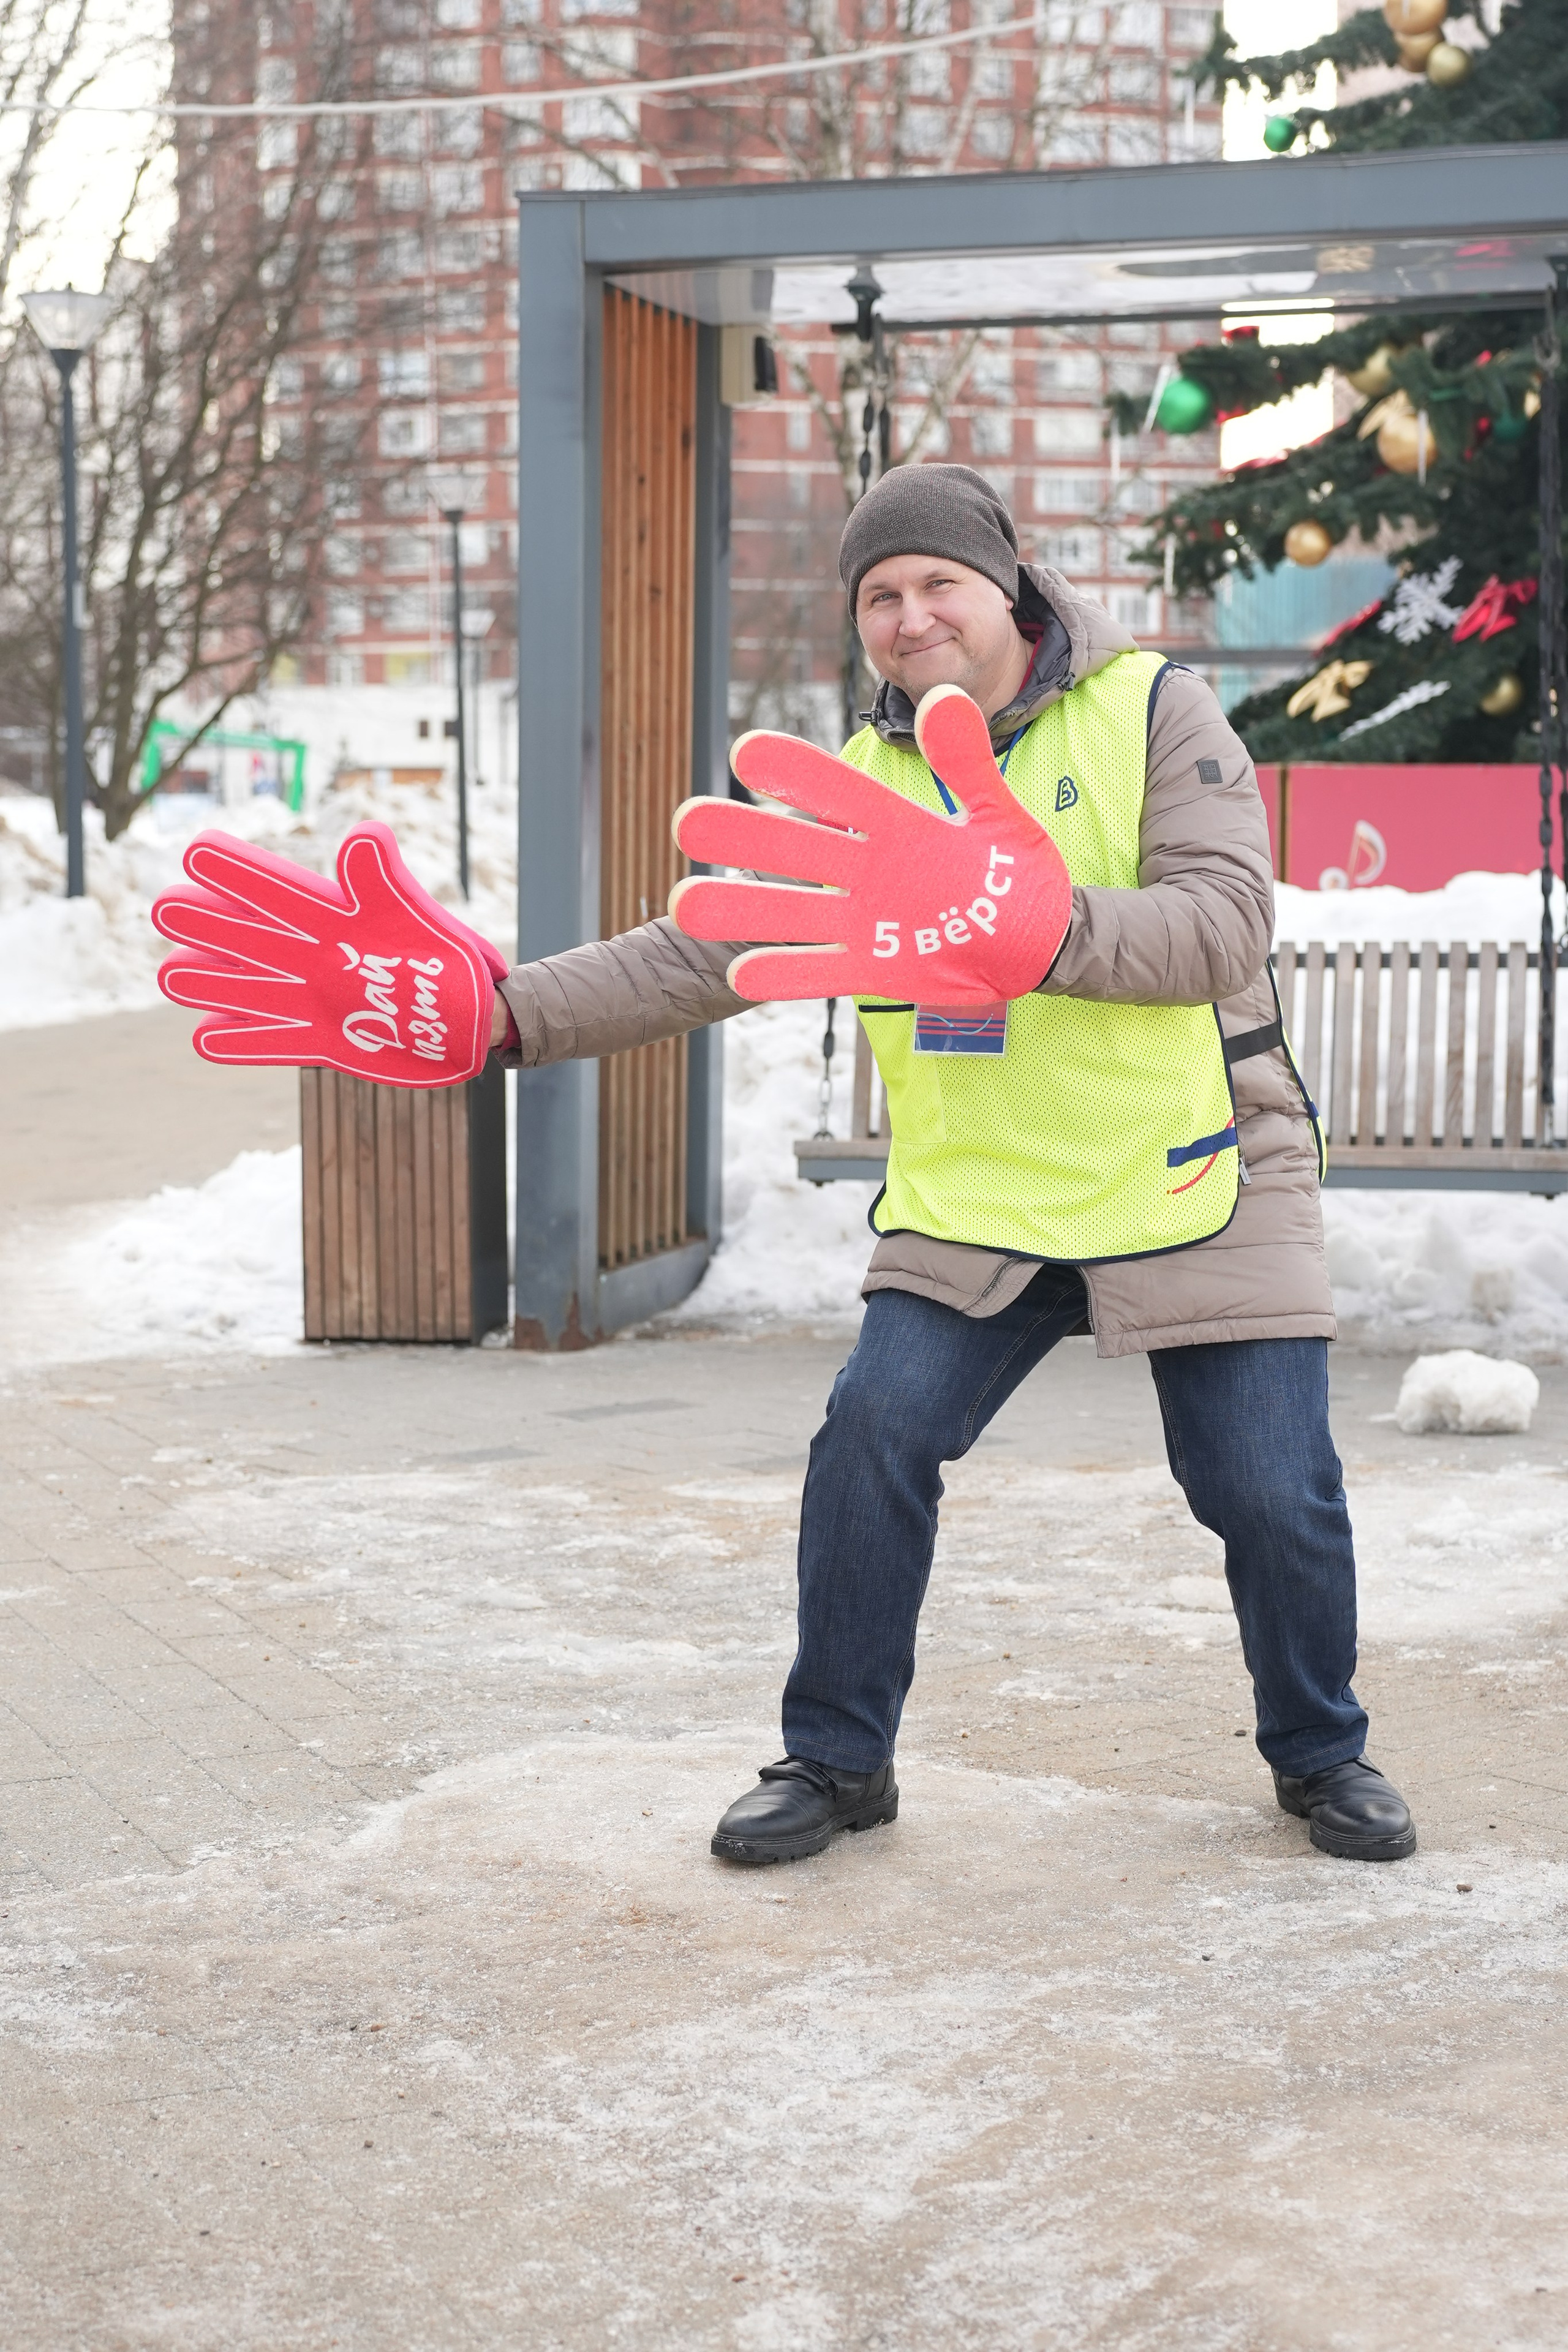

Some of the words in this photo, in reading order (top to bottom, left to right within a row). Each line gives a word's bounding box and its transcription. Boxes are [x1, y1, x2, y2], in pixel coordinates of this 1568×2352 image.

[873, 921, 900, 958] 5
[914, 845, 1014, 956] вёрст
[337, 942, 406, 1052] Дай
[407, 957, 448, 1061] пять
